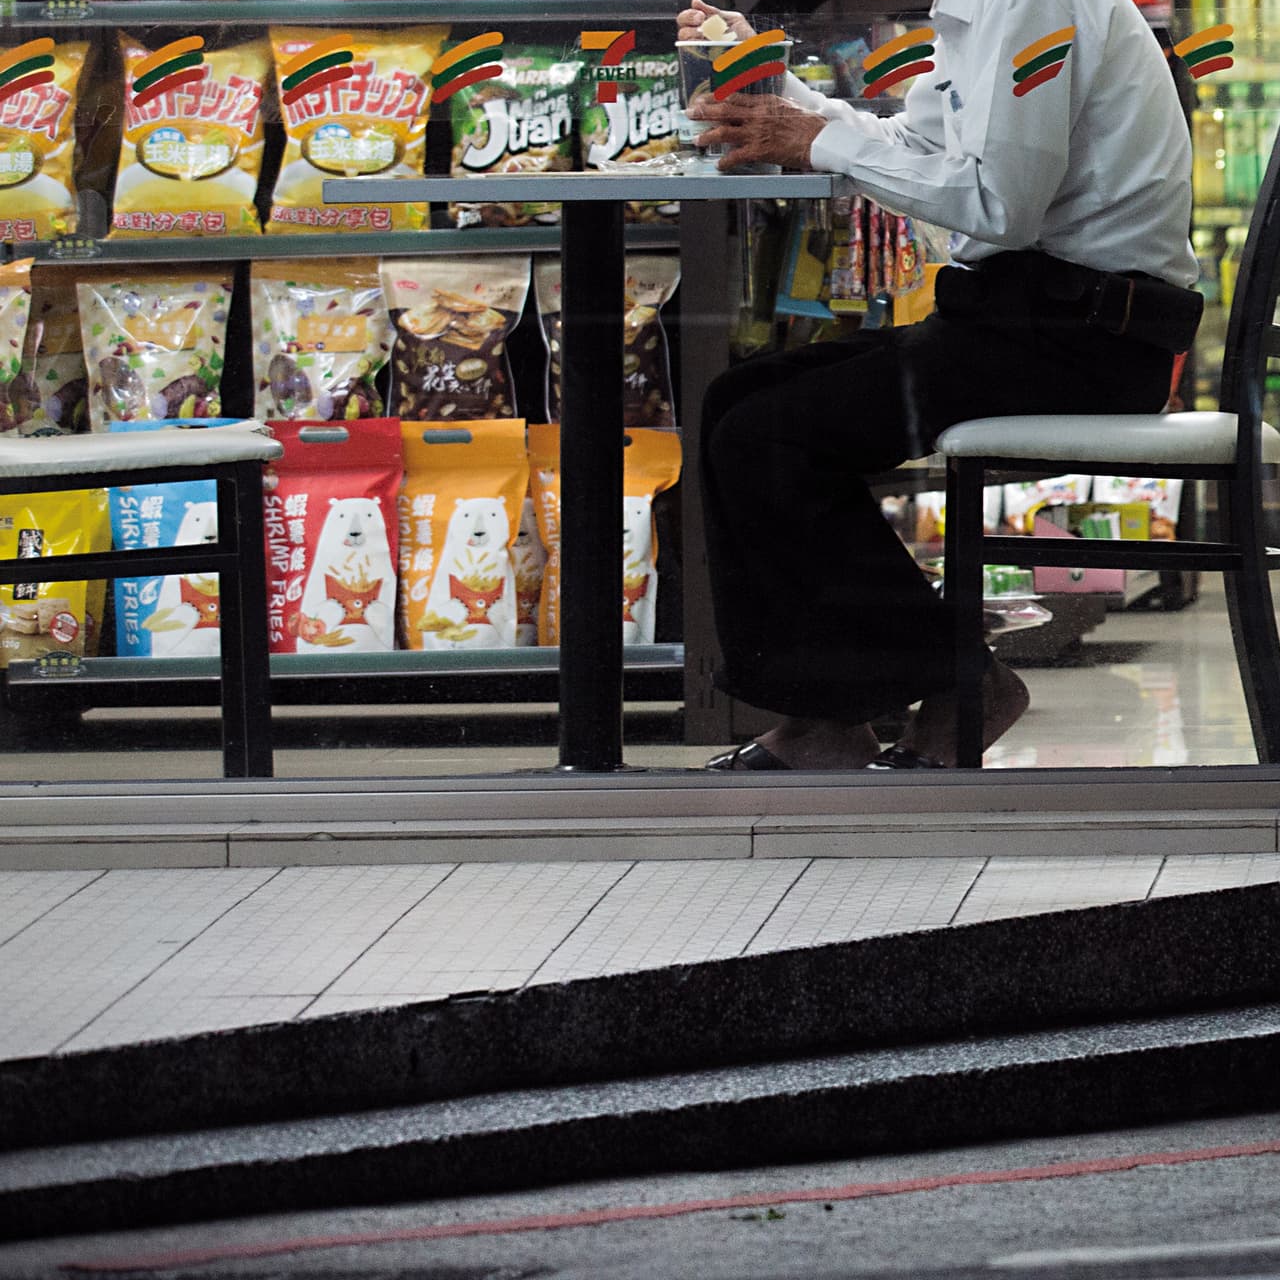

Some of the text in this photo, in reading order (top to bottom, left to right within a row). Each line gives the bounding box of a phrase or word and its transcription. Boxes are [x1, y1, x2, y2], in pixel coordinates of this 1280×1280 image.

[462, 97, 573, 170] Juan
[265, 495, 290, 573] SHRIMP
[122, 581, 140, 645] FRIES
[269, 580, 287, 643] FRIES
